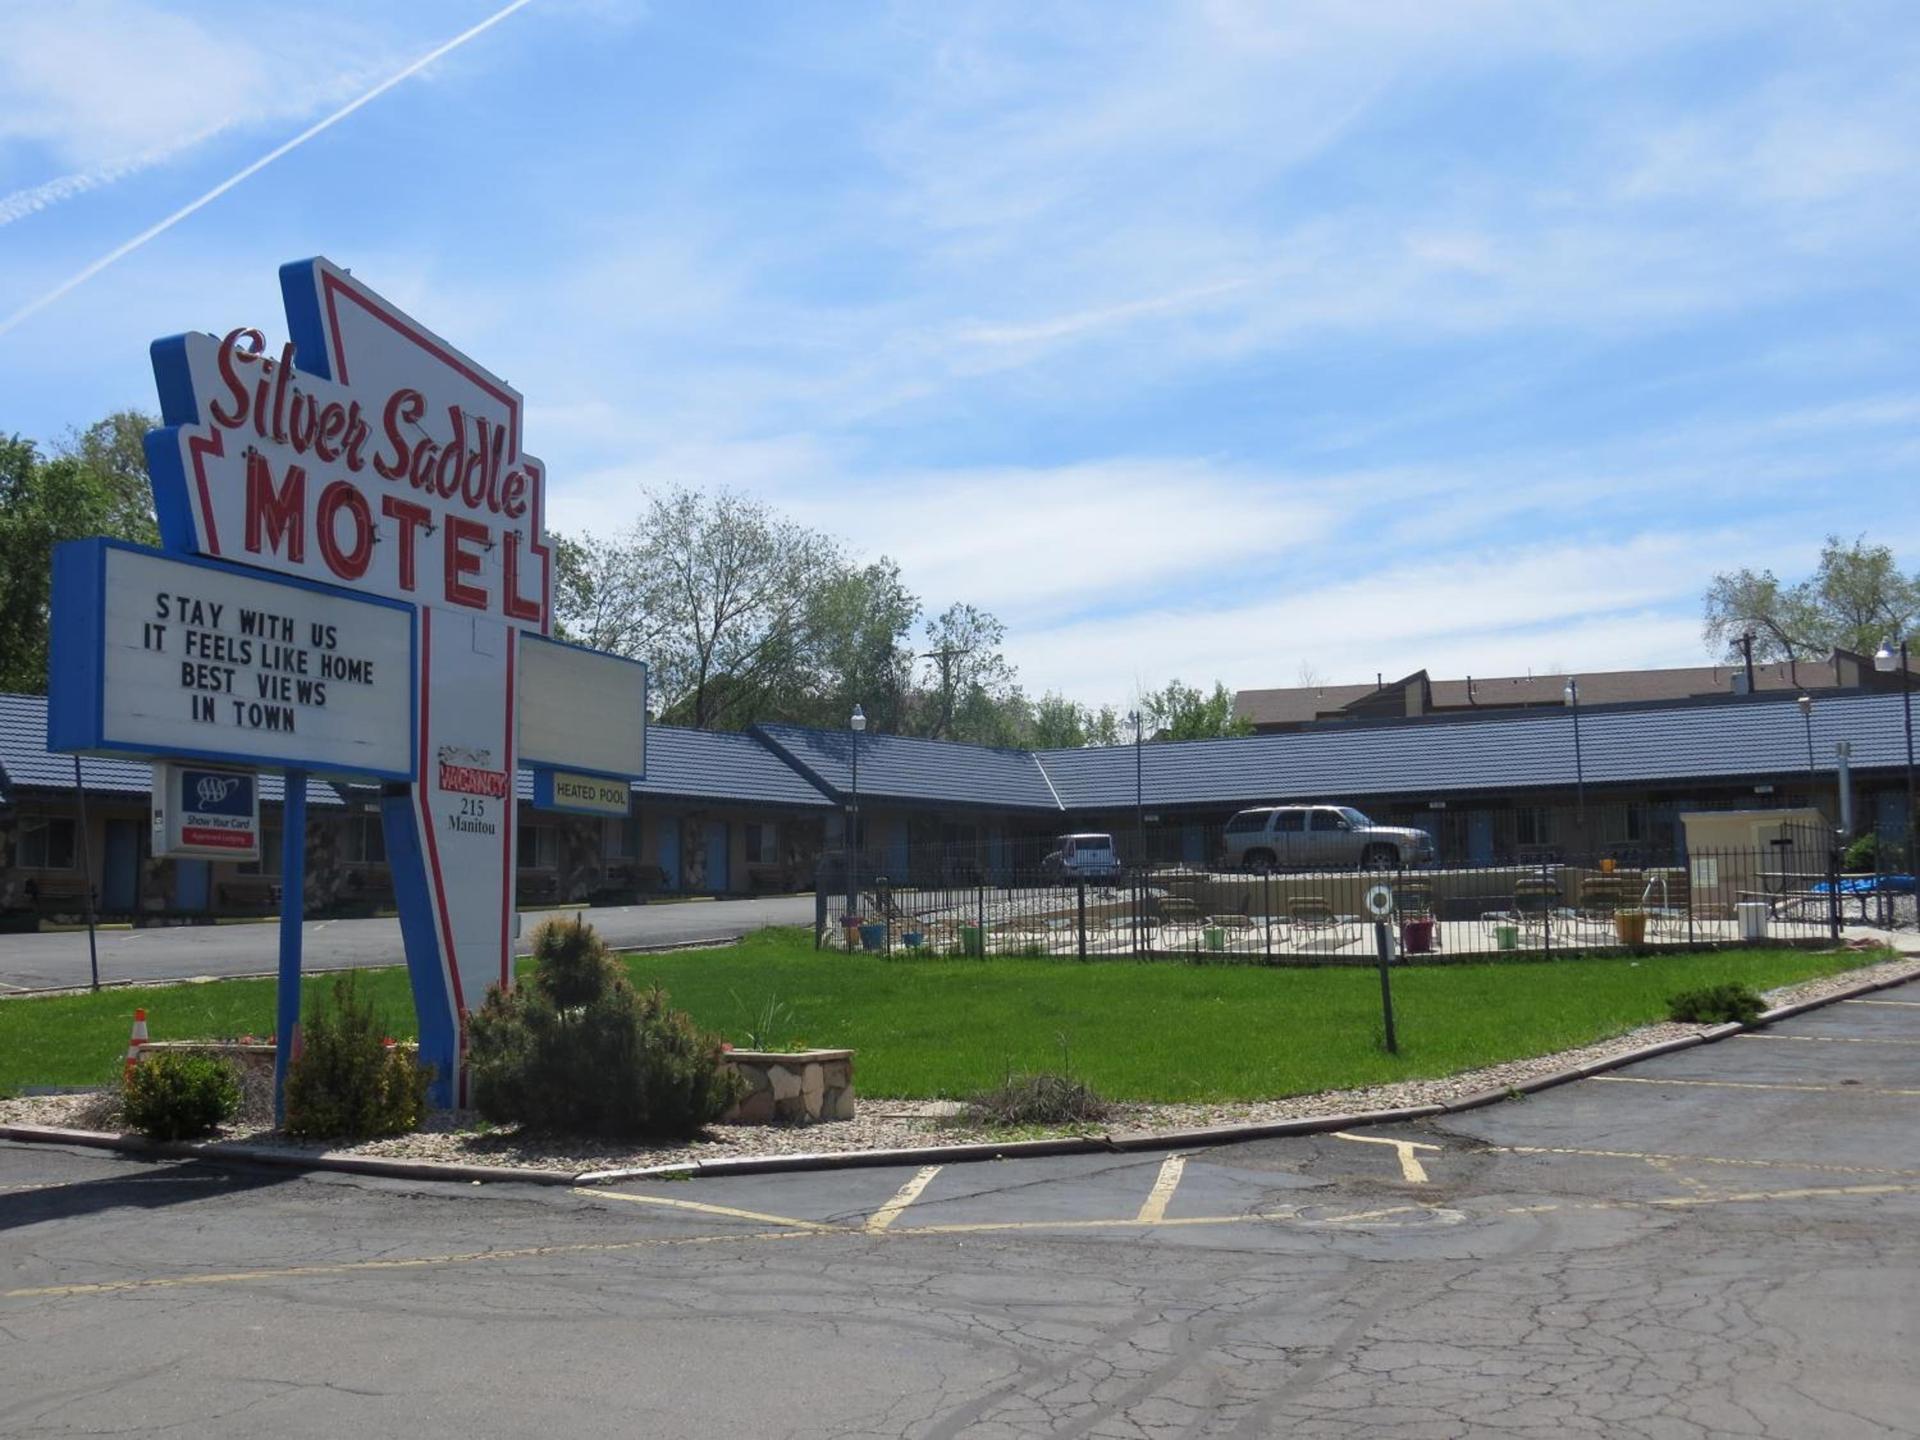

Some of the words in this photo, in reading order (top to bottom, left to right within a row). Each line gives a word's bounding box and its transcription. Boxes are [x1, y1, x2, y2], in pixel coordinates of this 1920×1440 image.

[210, 327, 366, 472] Silver
[374, 388, 528, 519] Saddle
[245, 450, 543, 618] MOTEL
[156, 593, 223, 629] STAY
[240, 608, 294, 643] WITH
[311, 623, 337, 650] US
[144, 623, 167, 650] IT
[186, 630, 252, 666] FEELS
[262, 643, 308, 675] LIKE
[321, 654, 374, 685] HOME
[181, 661, 235, 694] BEST
[257, 673, 327, 706] VIEWS
[191, 694, 215, 722] IN
[233, 700, 295, 733] TOWN
[441, 766, 506, 798] VACANCY
[557, 782, 596, 801] HEATED
[600, 787, 626, 805] POOL
[188, 814, 210, 826] Show
[212, 816, 230, 827] Your
[232, 818, 250, 829] Card
[448, 815, 496, 836] Manitou
[460, 797, 485, 817] 215
